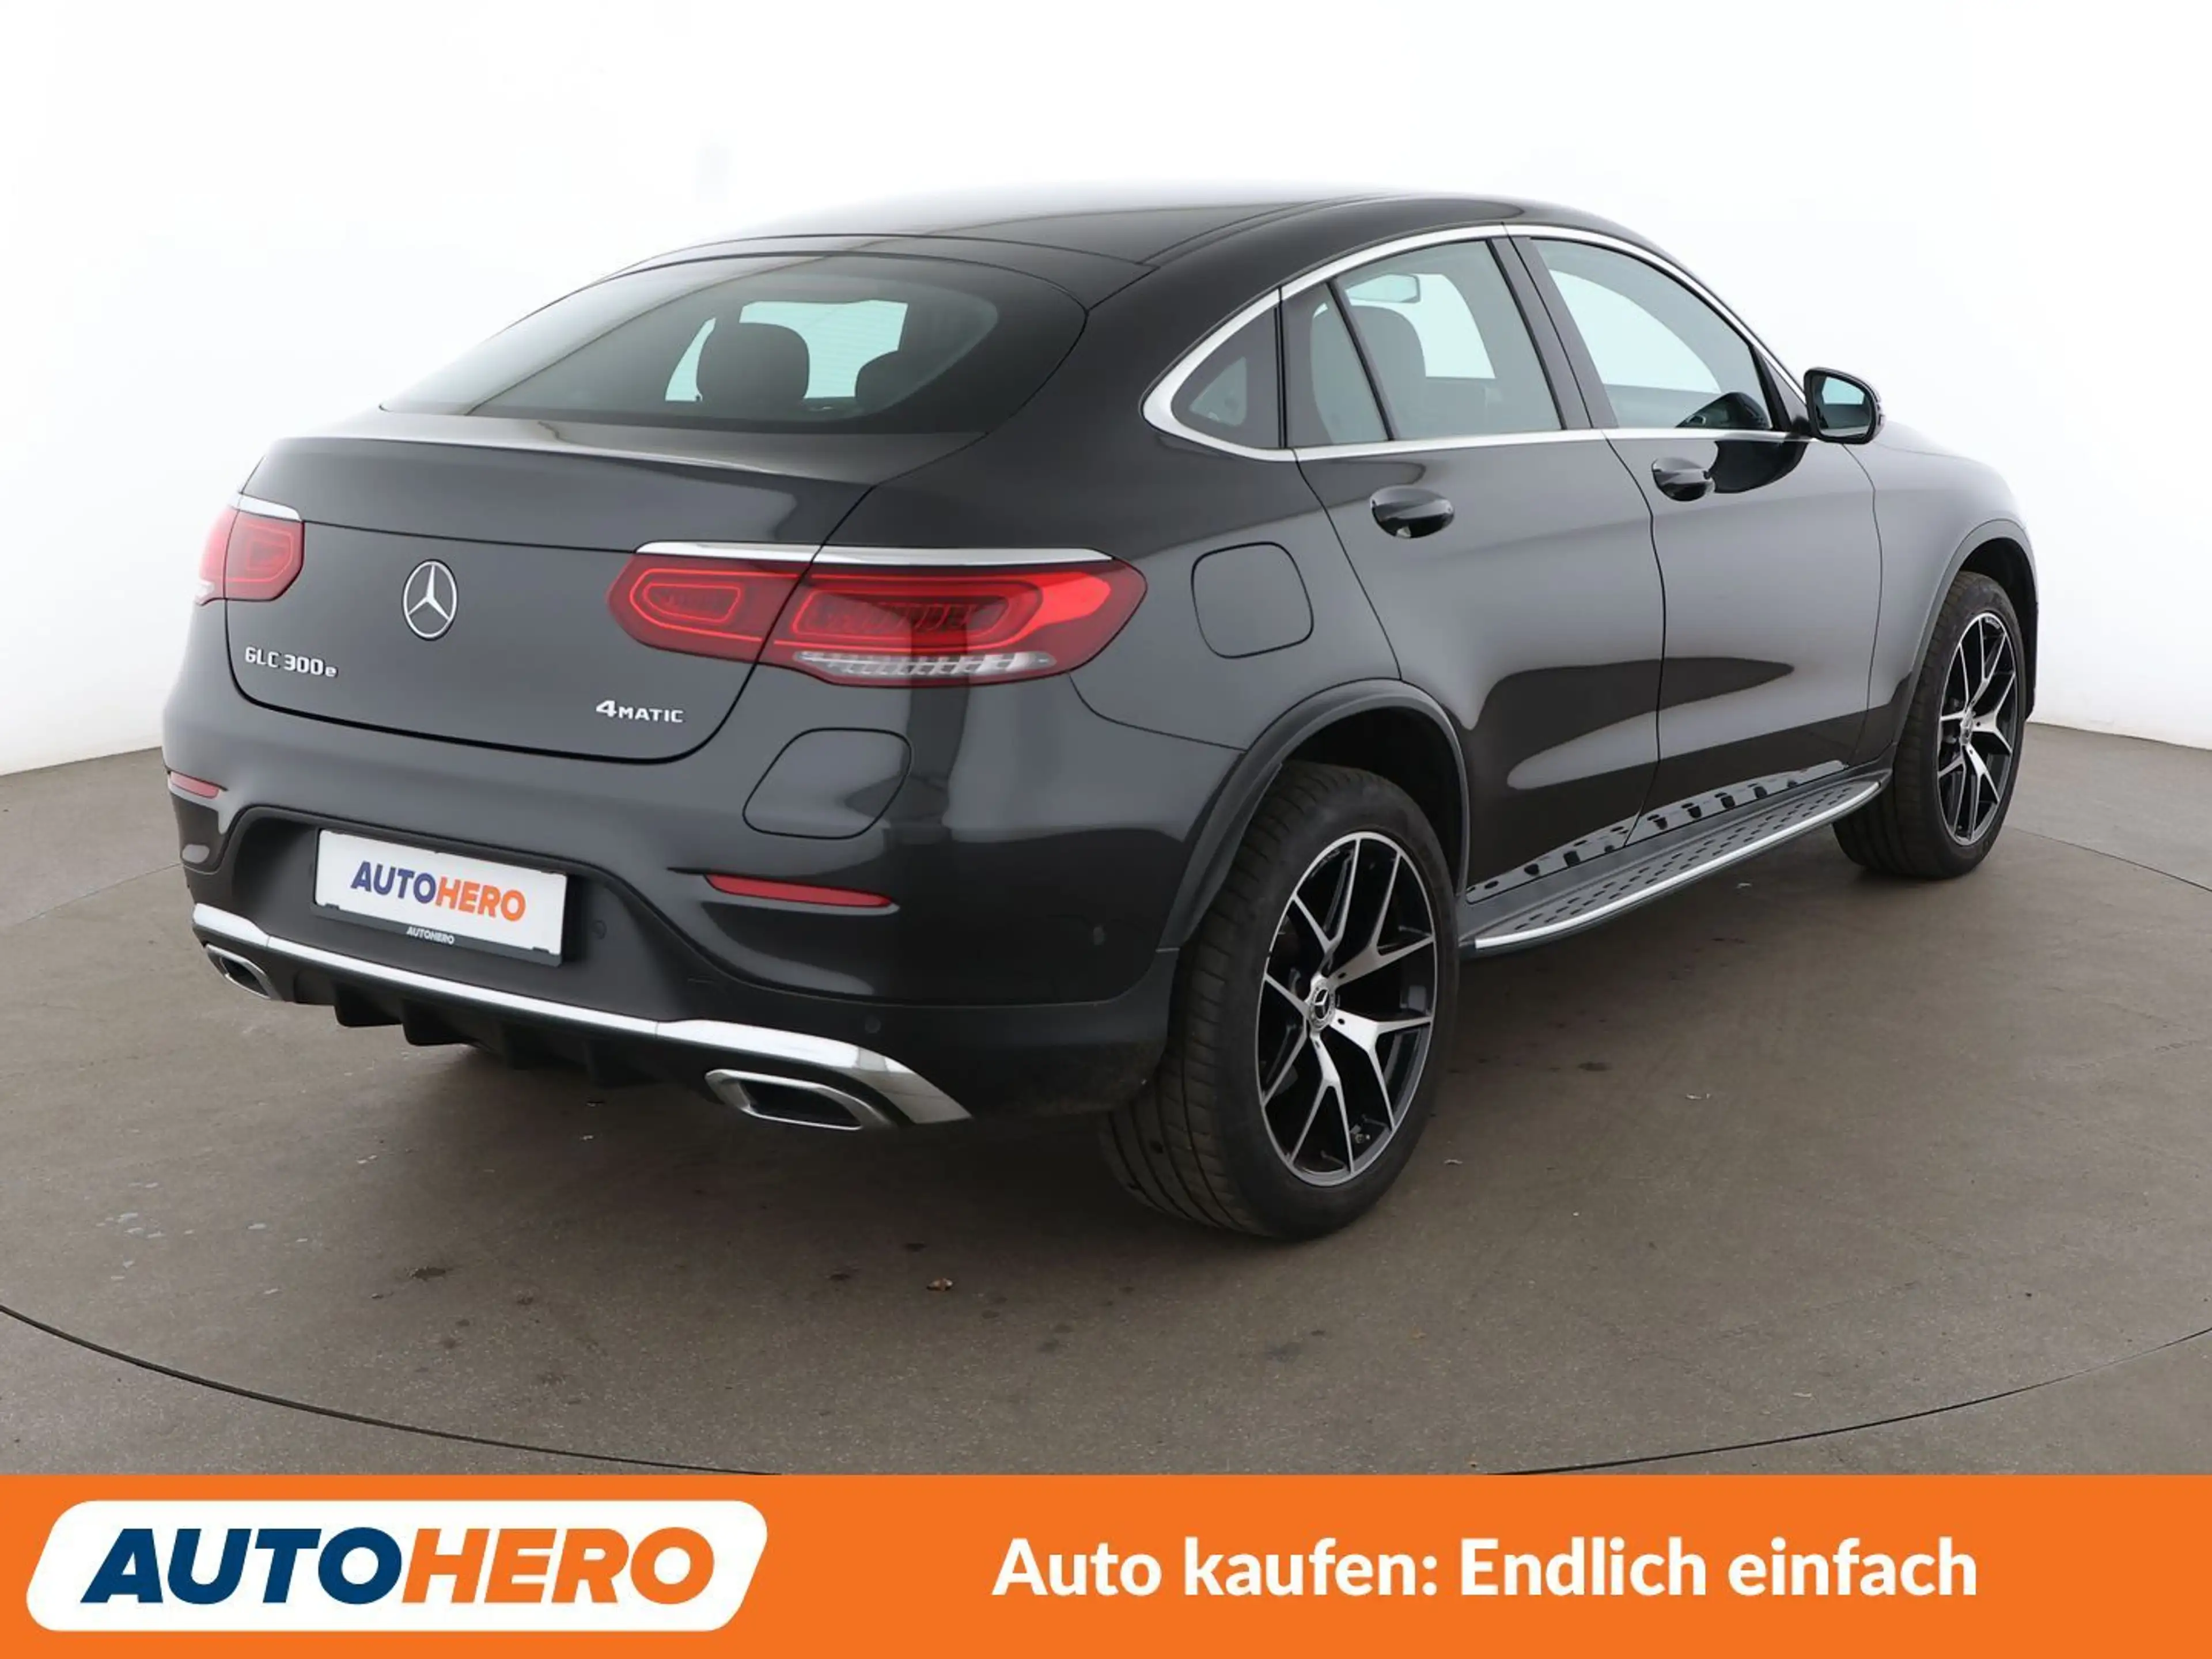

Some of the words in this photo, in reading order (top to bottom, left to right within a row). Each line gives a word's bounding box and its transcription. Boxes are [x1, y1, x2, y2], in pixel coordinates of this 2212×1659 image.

[245, 646, 280, 668] GLC
[283, 654, 338, 677] 300e
[596, 699, 684, 723] 4MATIC
[350, 860, 527, 922] AUTOHERO
[406, 926, 454, 945] AUTOHERO
